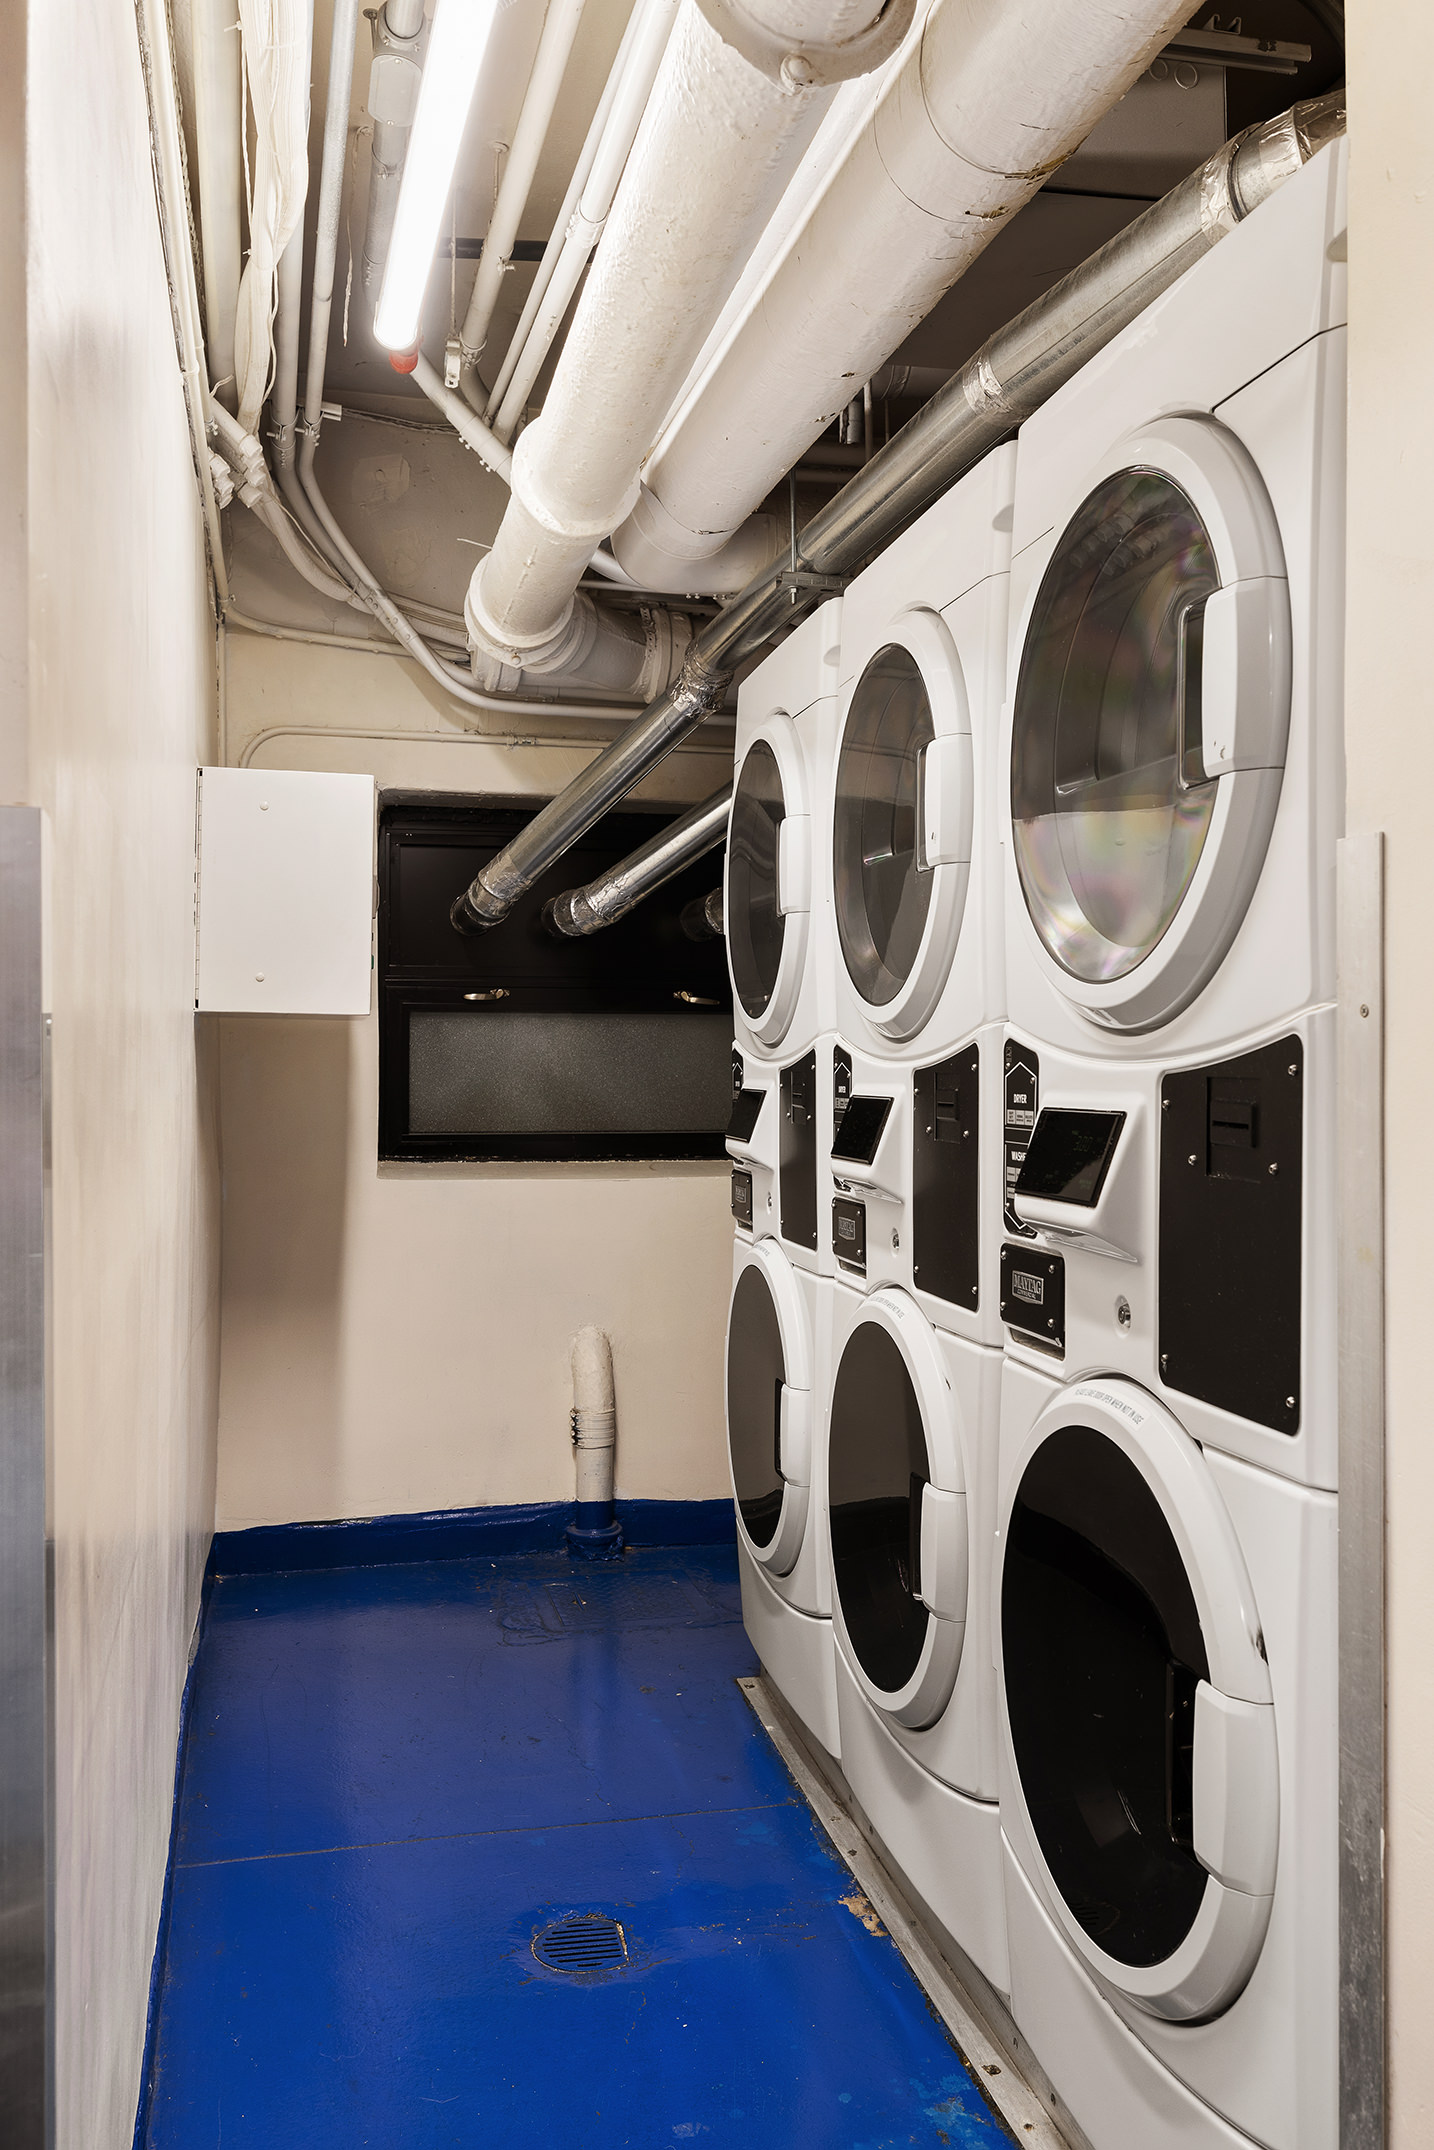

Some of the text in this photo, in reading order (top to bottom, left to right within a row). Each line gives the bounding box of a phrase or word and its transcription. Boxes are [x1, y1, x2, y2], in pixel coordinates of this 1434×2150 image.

[1013, 1093, 1027, 1104] DRYER
[1011, 1150, 1027, 1162] WASHE
[1014, 1274, 1041, 1294] MAYTAG
[1110, 1397, 1124, 1410] WHEN
[1121, 1404, 1132, 1415] NOT
[1132, 1413, 1144, 1425] USE
